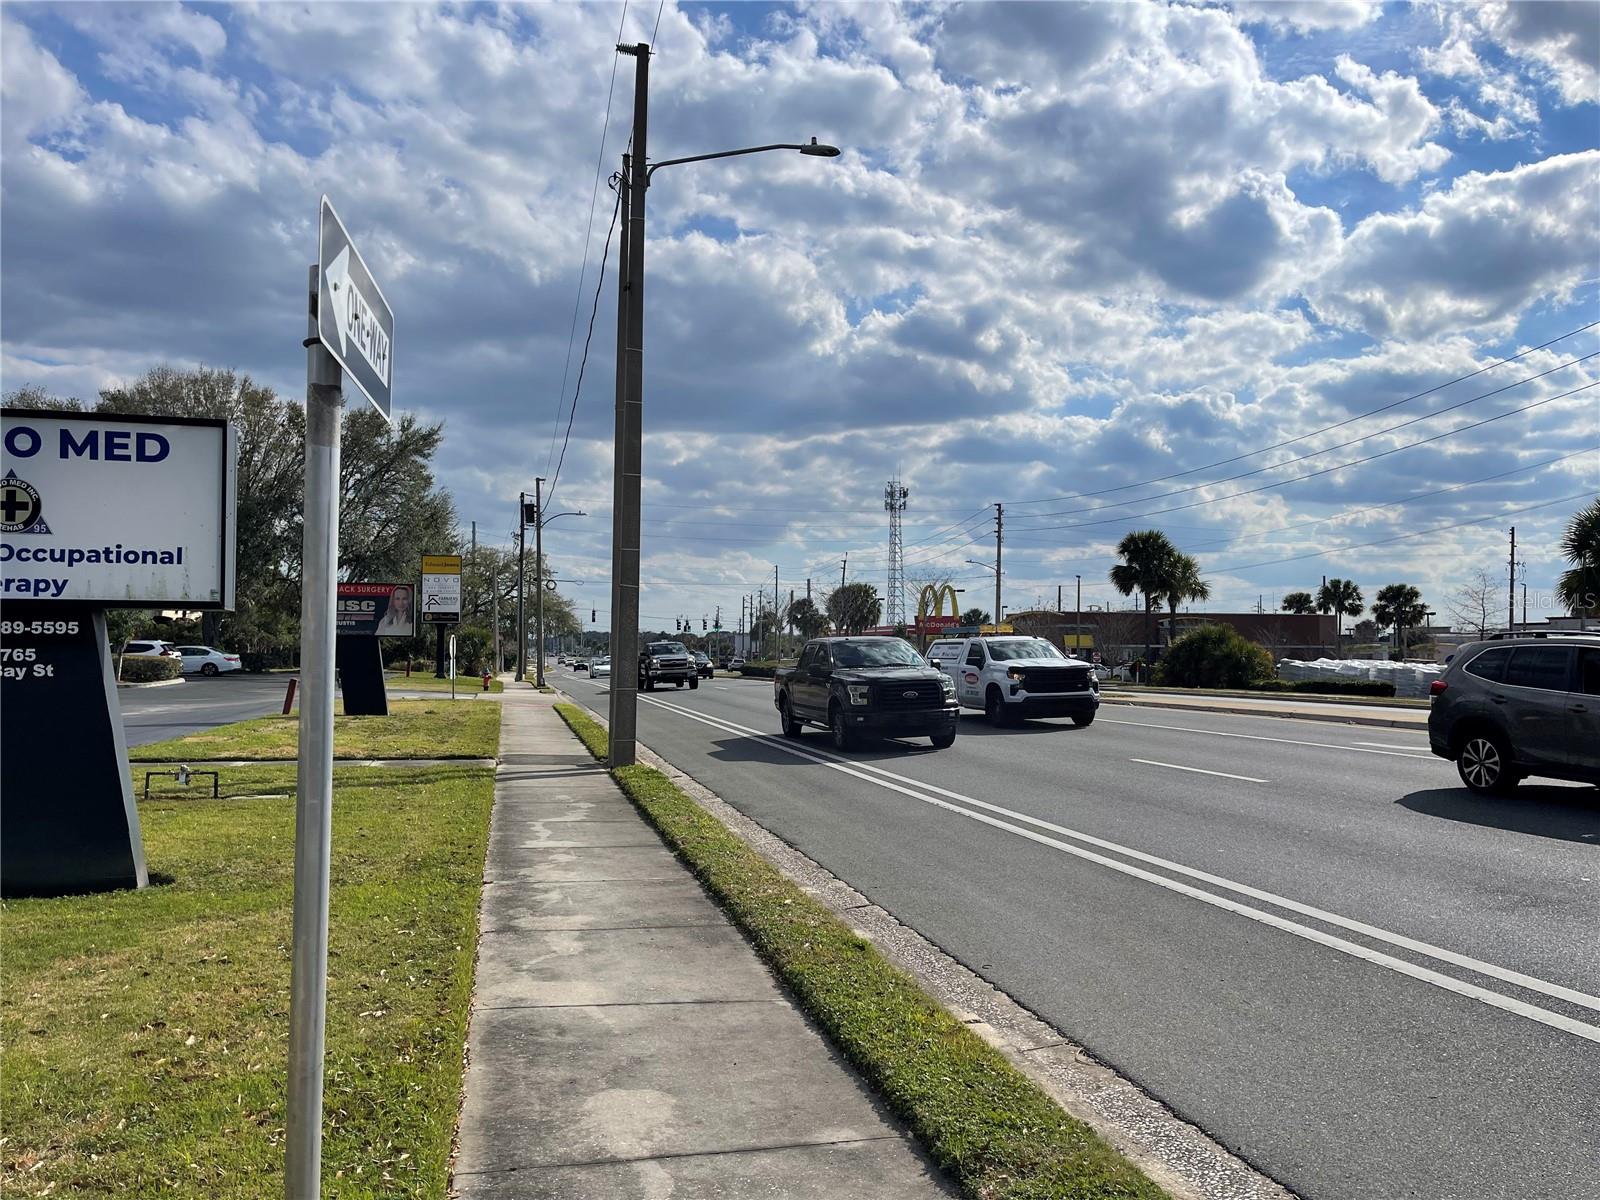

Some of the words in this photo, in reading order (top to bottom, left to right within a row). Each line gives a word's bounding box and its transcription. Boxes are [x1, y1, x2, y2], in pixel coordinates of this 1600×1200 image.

[347, 284, 367, 351] ONE
[369, 317, 388, 377] WAY
[4, 426, 42, 458] O
[59, 428, 171, 463] MED
[10, 480, 27, 489] MED
[33, 524, 47, 533] 95
[0, 544, 183, 567] Occupational
[0, 577, 69, 597] rapy
[337, 585, 356, 593] ACK
[0, 621, 79, 634] 89-5595
[0, 648, 36, 661] 765
[0, 664, 27, 681] ay
[33, 664, 54, 677] St
